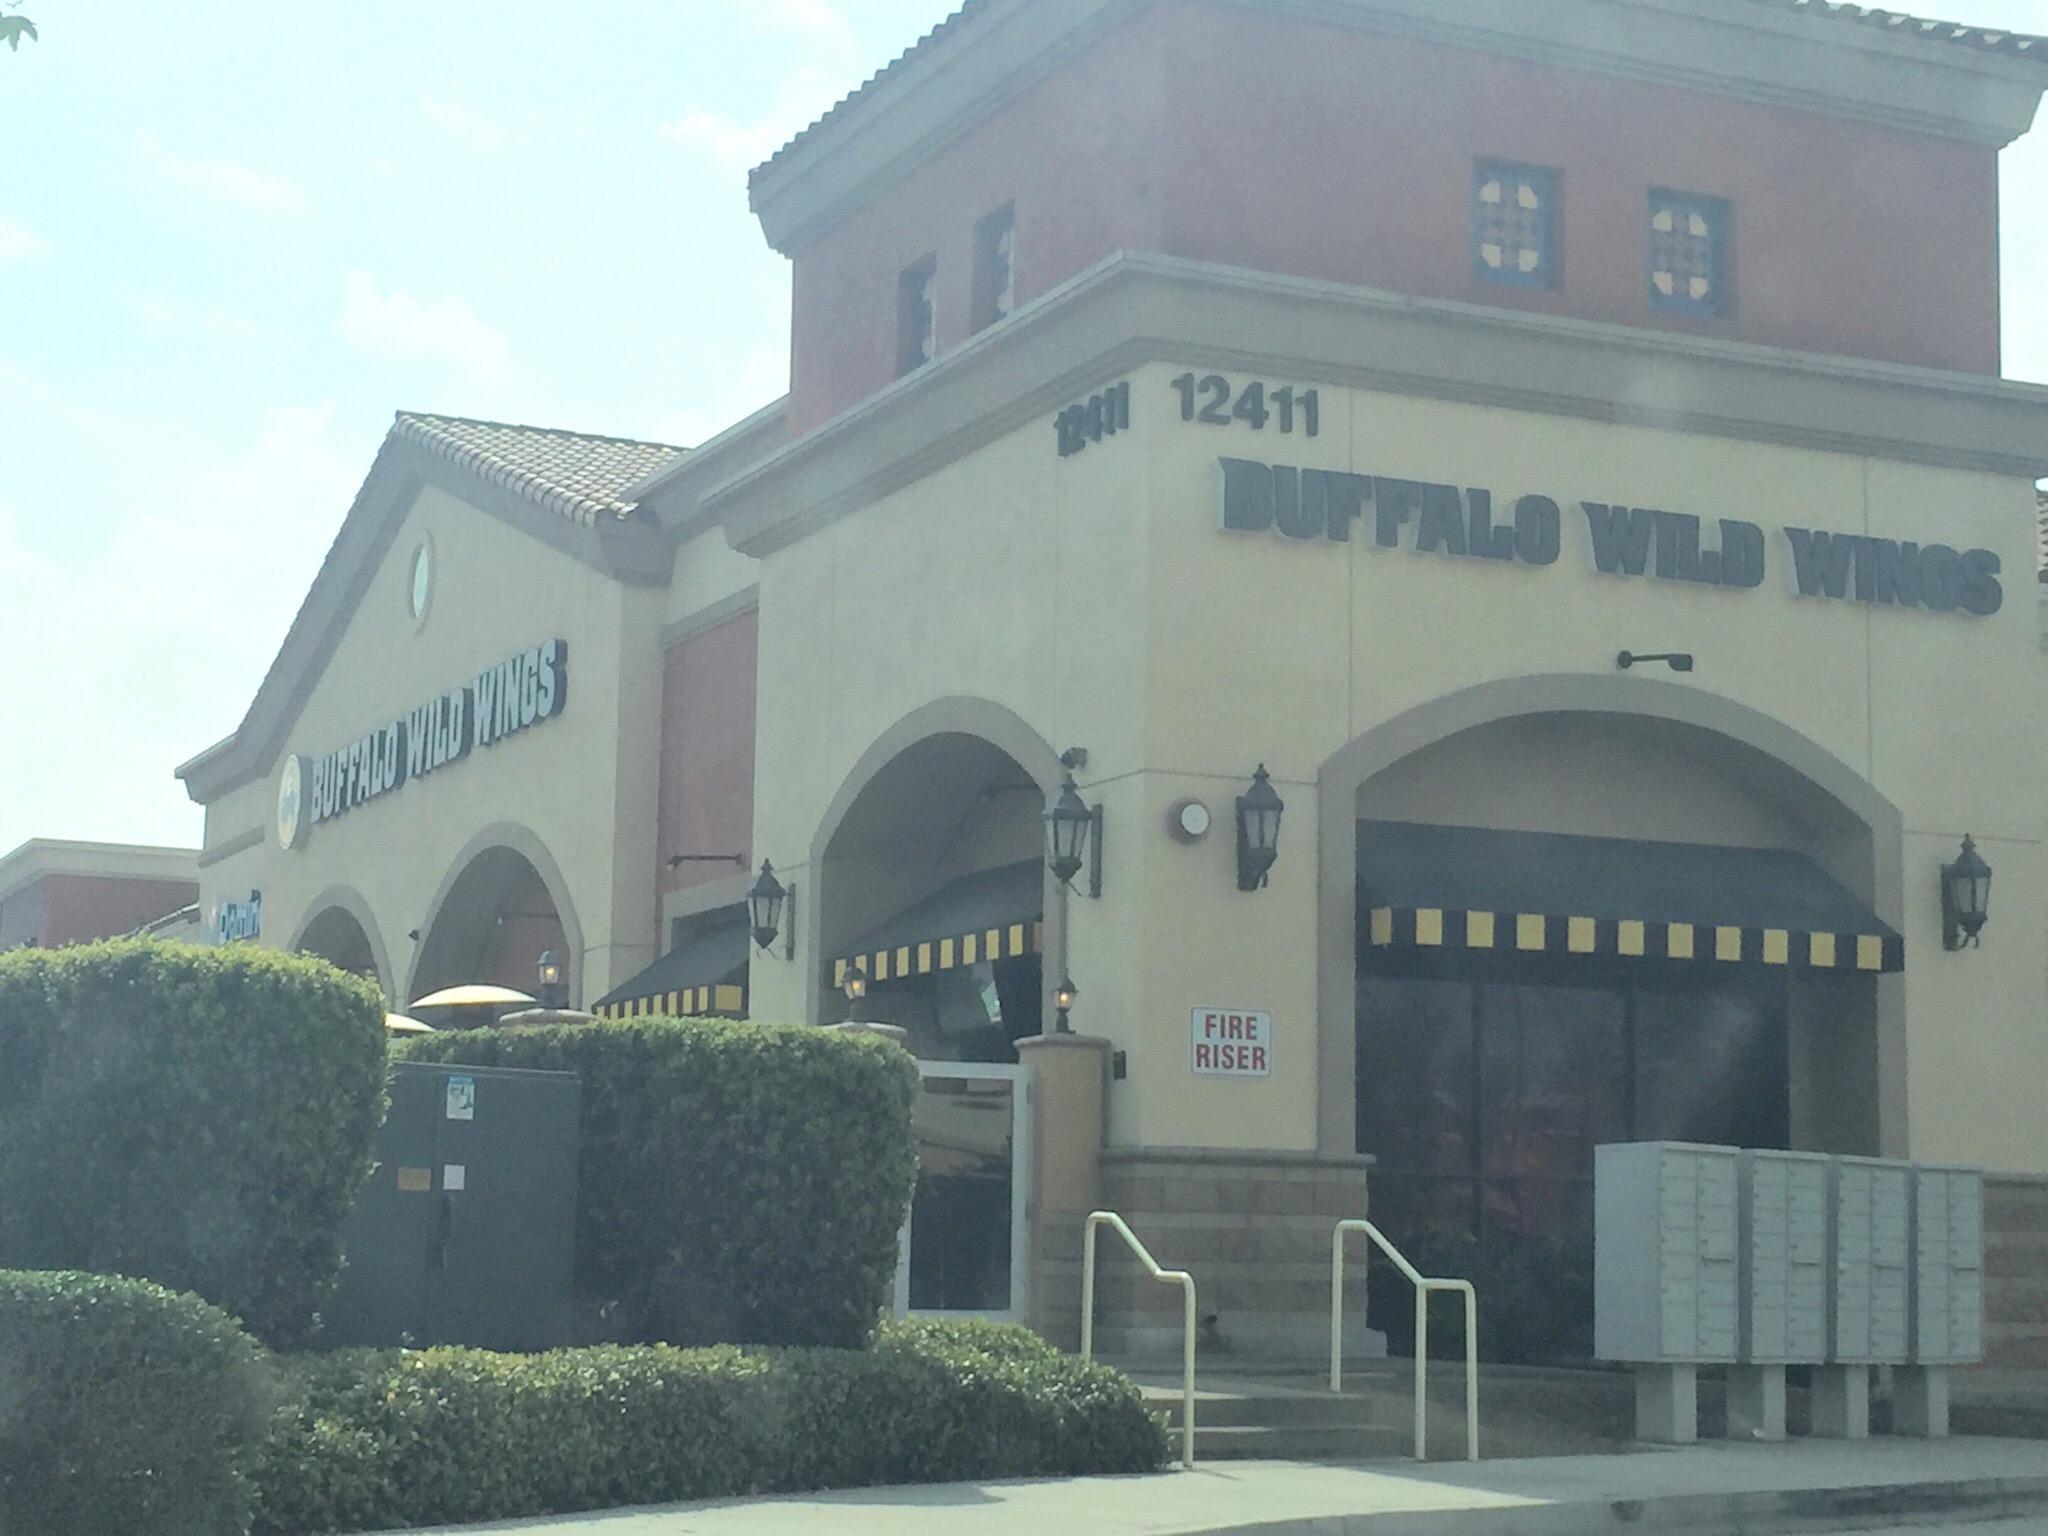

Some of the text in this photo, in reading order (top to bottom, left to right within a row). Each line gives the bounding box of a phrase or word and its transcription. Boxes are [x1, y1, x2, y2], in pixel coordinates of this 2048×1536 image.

[1053, 380, 1130, 458] 12411
[1170, 371, 1319, 438] 12411
[1216, 455, 2004, 617] BUFFALO WILD WINGS
[310, 638, 564, 825] BUFFALO WILD WINGS
[1195, 1043, 1266, 1071] RISER
[1204, 1013, 1258, 1041] FIRE
